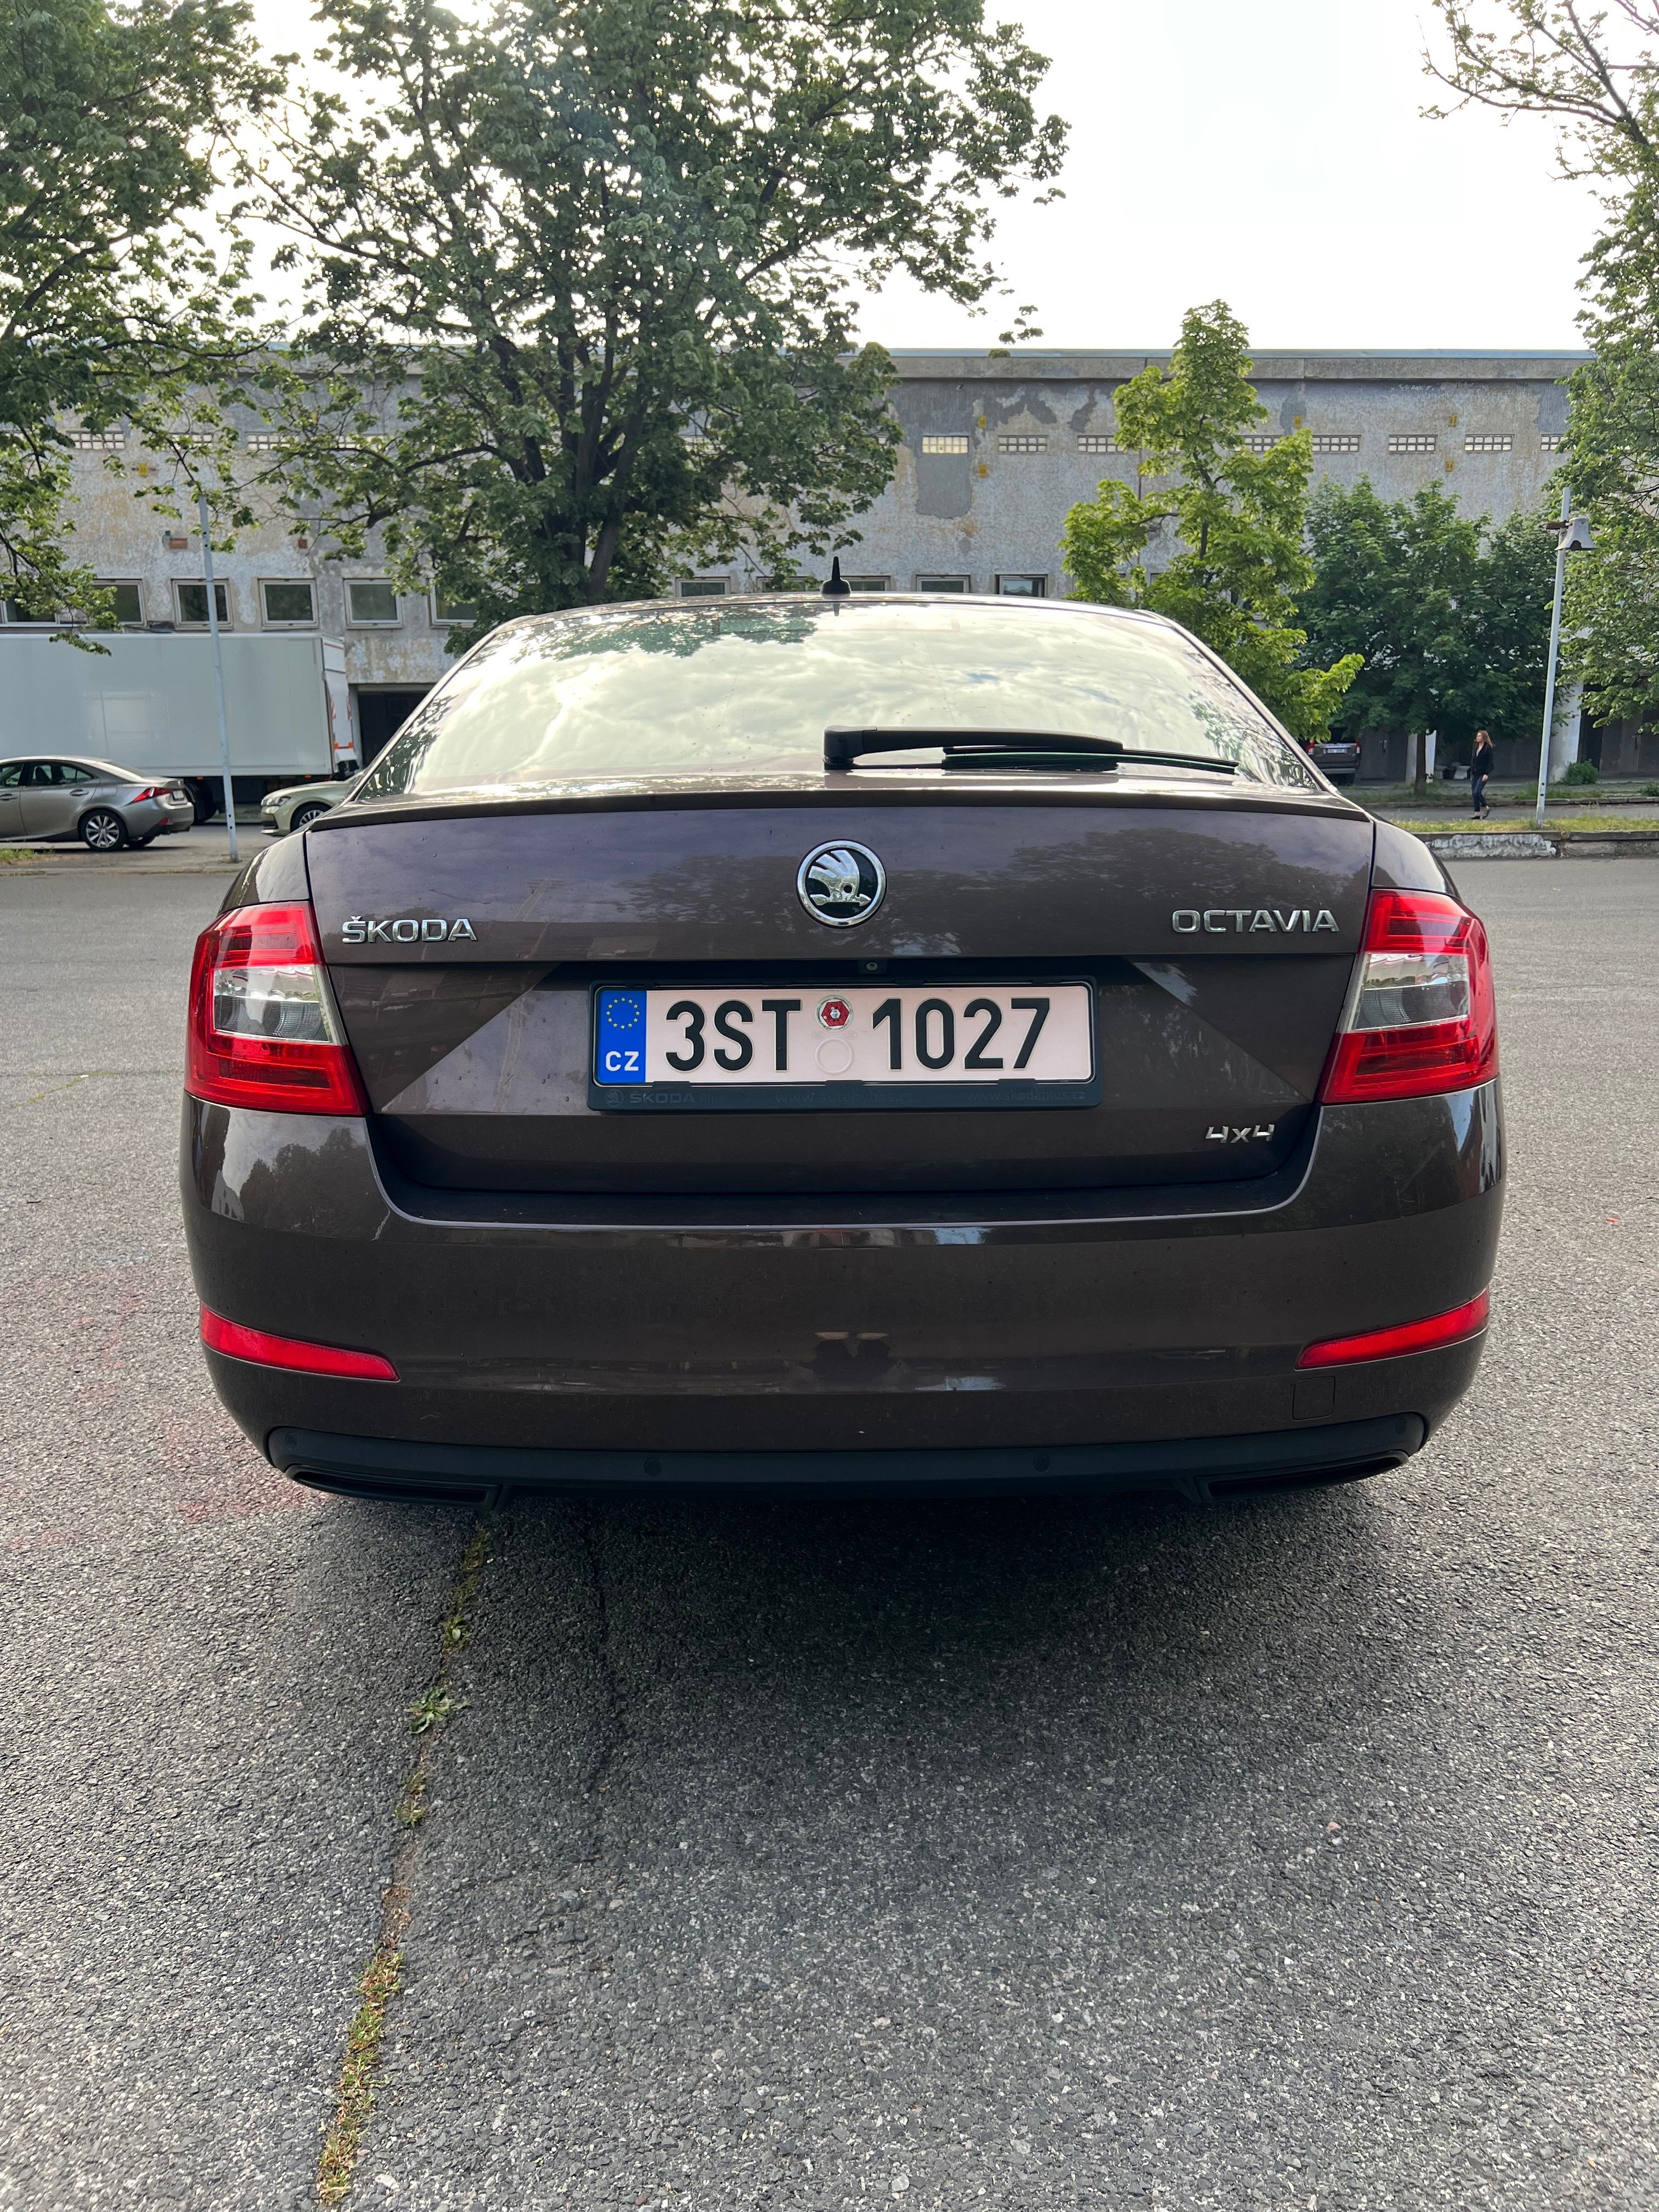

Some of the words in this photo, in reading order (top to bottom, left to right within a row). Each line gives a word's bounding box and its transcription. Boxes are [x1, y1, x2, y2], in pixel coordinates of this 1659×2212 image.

[342, 915, 477, 944] ŠKODA
[1172, 910, 1340, 933] OCTAVIA
[665, 998, 802, 1072] 3ST
[872, 998, 1050, 1070] 1027
[605, 1051, 640, 1072] CZ
[630, 1091, 696, 1104] ŠKODA
[967, 1089, 1086, 1102] www.skodaplus.cz
[1205, 1124, 1275, 1144] 4x4
